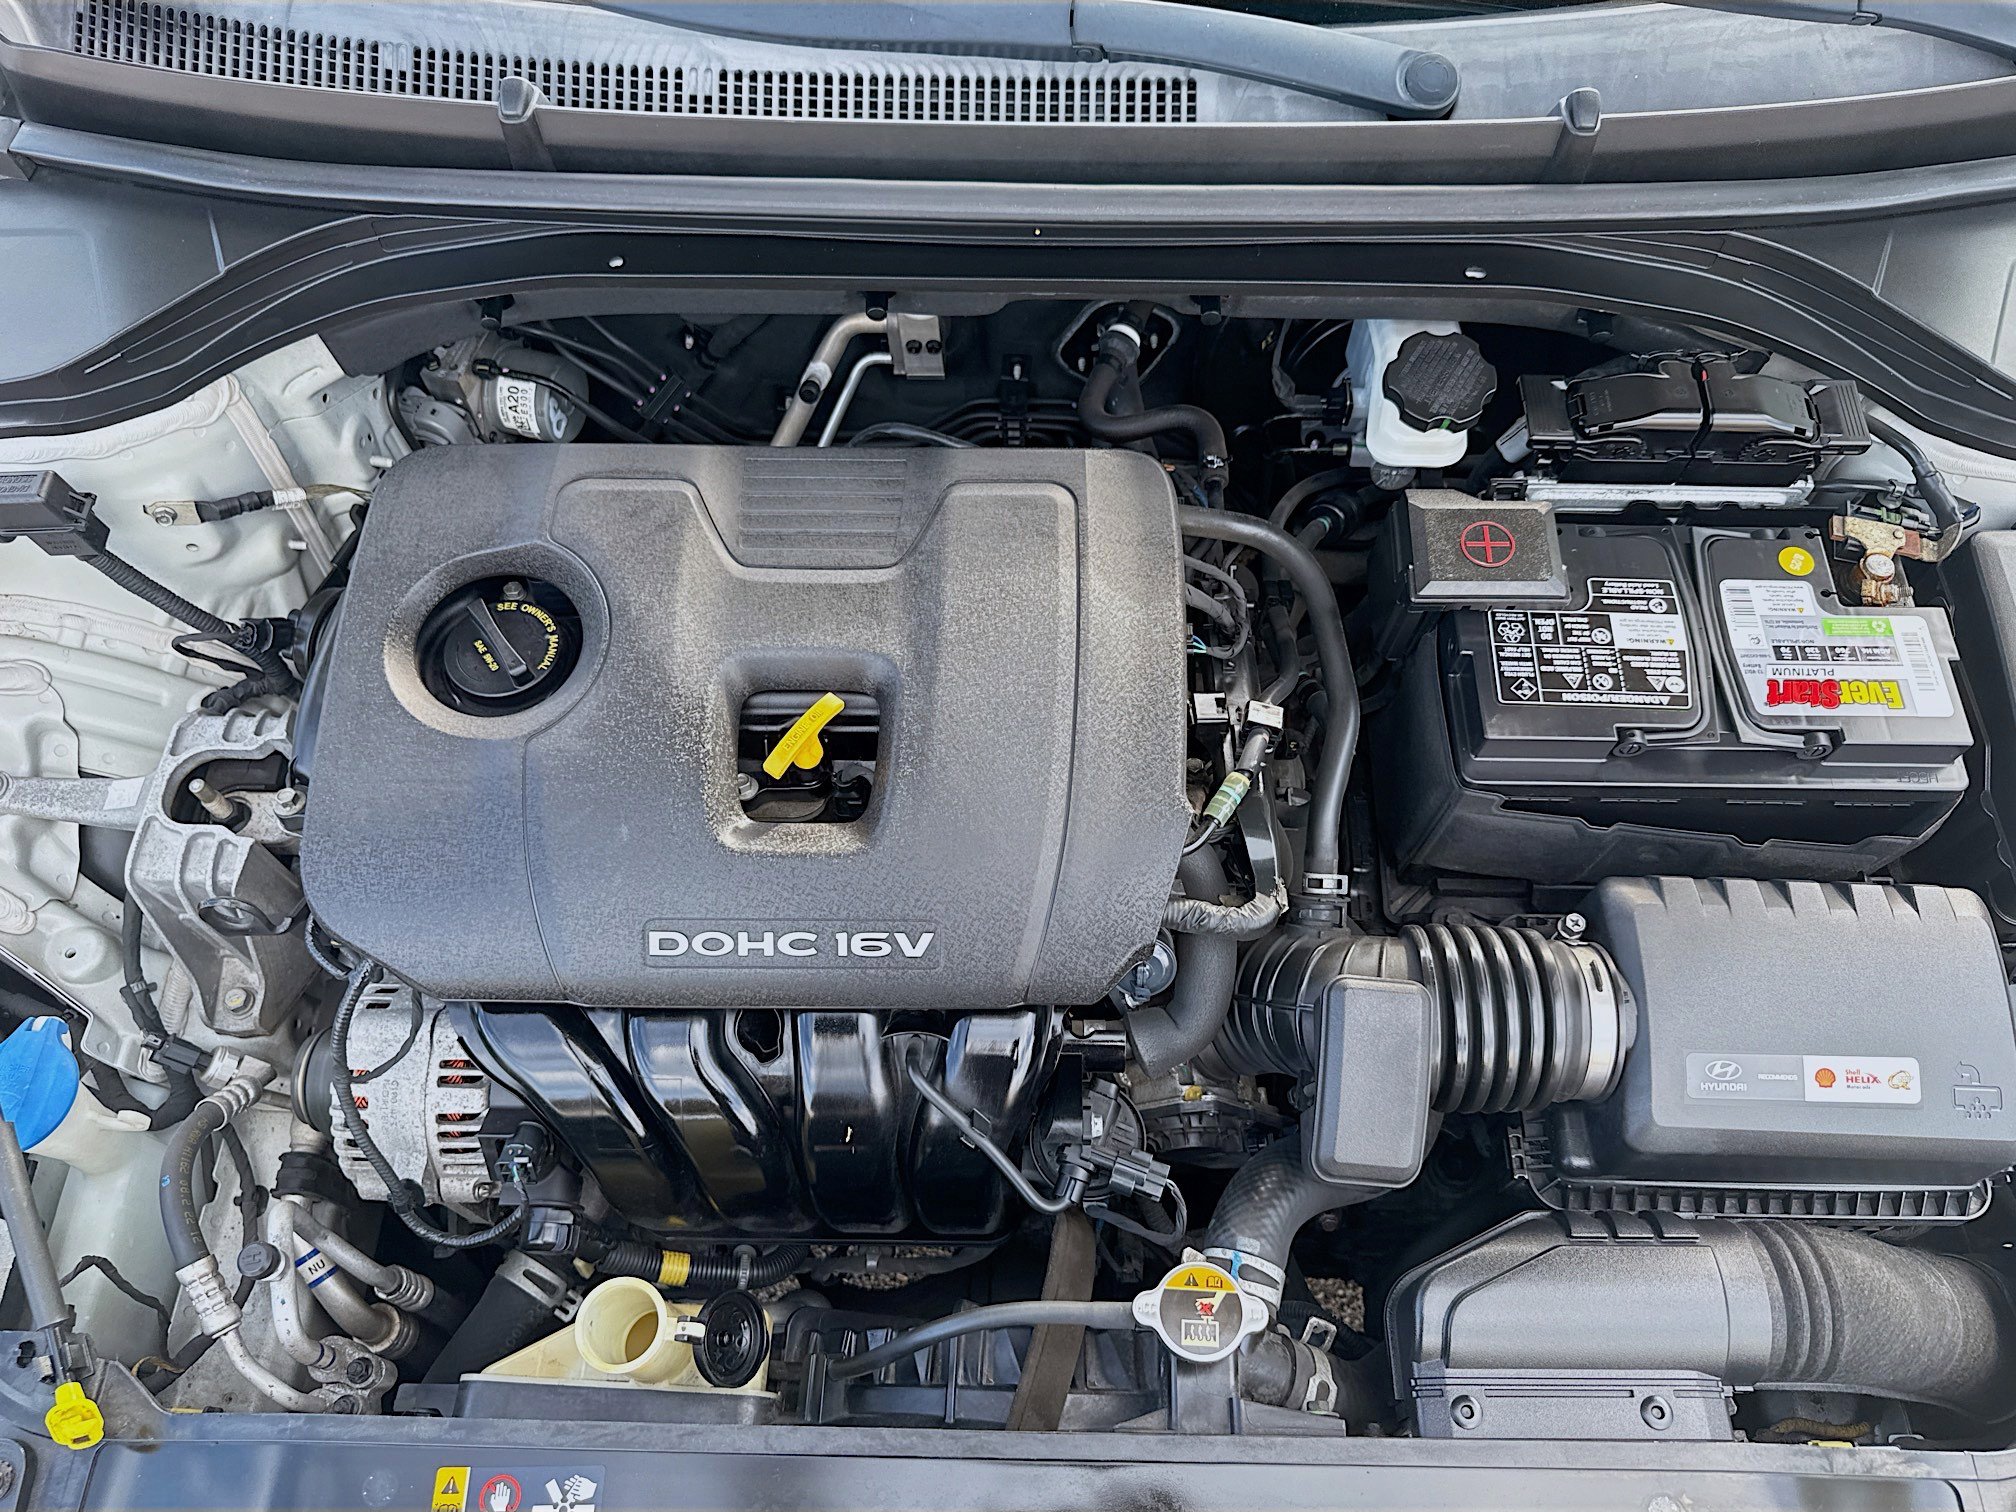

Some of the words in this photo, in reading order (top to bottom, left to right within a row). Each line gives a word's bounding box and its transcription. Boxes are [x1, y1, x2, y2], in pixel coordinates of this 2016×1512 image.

[508, 386, 519, 415] A20
[496, 602, 518, 611] SEE
[521, 603, 557, 633] OWNER'S
[473, 639, 488, 654] SAE
[537, 634, 559, 671] MANUAL
[1772, 668, 1834, 676] PLATINUM
[1562, 693, 1660, 703] DANGER/POISON
[1767, 679, 1905, 709] EverStart
[782, 720, 809, 750] ENGINE
[810, 708, 823, 721] OIL
[648, 930, 818, 957] DOHC
[835, 931, 935, 958] 16V
[1700, 1082, 1747, 1092] HYUNDAI
[1846, 1075, 1881, 1084] HELIX
[308, 1259, 326, 1275] NU
